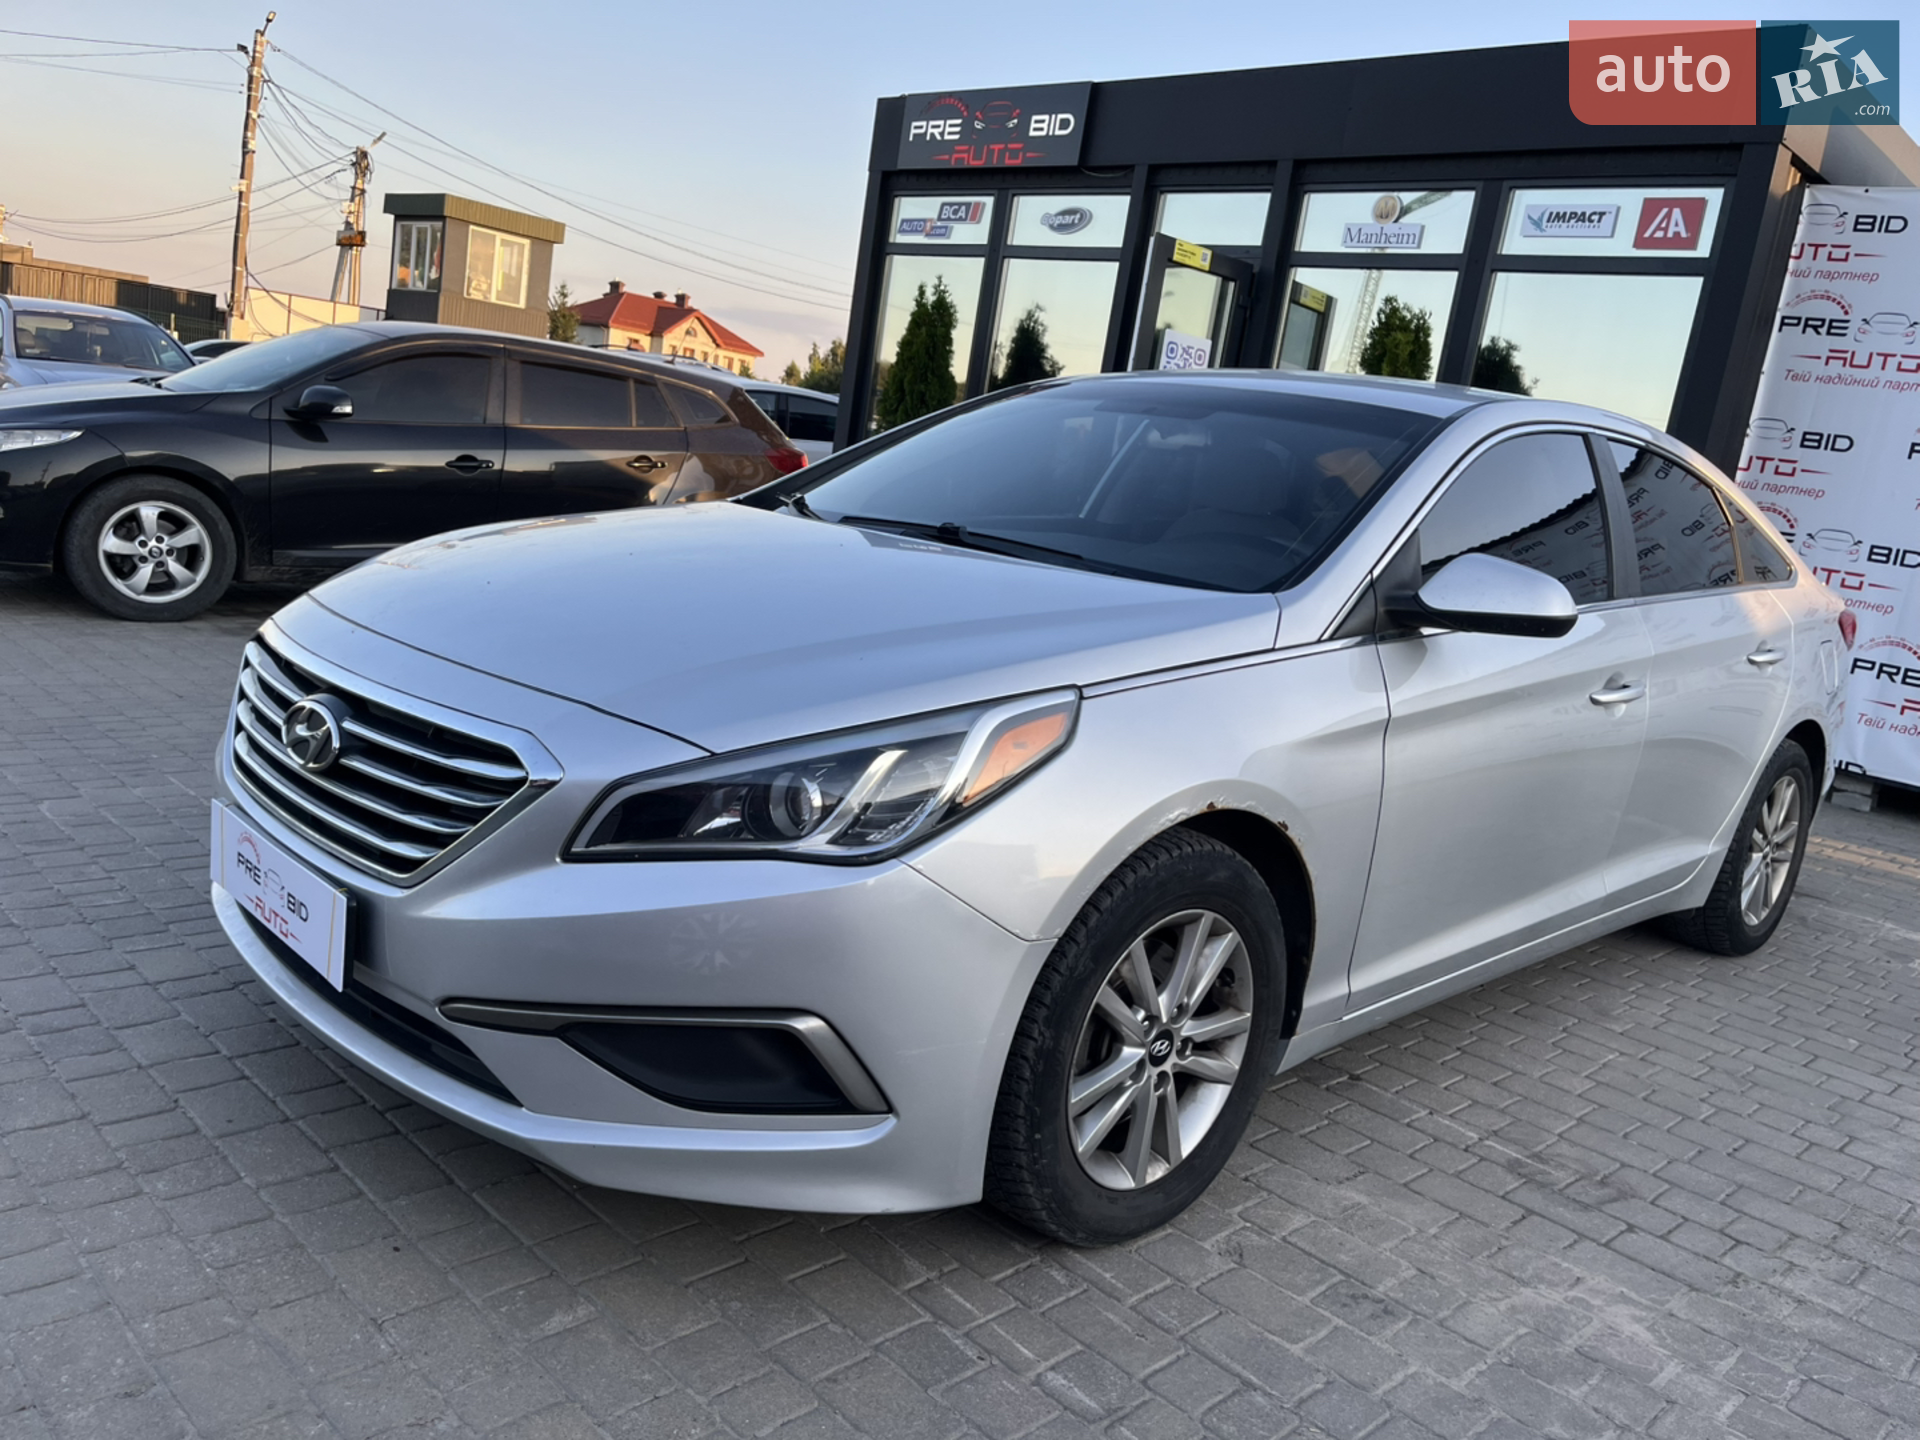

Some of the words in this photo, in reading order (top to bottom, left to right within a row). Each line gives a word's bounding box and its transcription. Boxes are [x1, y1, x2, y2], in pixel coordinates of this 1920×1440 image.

[909, 119, 963, 141] PRE
[1028, 113, 1075, 137] BID
[951, 143, 1024, 166] AUTO
[941, 204, 966, 219] BCA
[1040, 212, 1080, 227] Copart
[1546, 211, 1607, 224] IMPACT
[1852, 214, 1909, 234] BID
[1344, 227, 1417, 245] Manheim
[1789, 242, 1852, 263] UTO
[1814, 268, 1880, 284] партнер
[1778, 315, 1851, 337] PRE
[1825, 348, 1920, 373] AUTO
[1784, 368, 1812, 382] Твій
[1814, 372, 1880, 389] надійний
[1882, 378, 1920, 393] парт
[1799, 431, 1855, 453] BID
[1737, 455, 1799, 477] UTO
[1760, 481, 1826, 500] партнер
[1866, 544, 1920, 569] BID
[1850, 657, 1920, 688] PRE
[1857, 712, 1886, 729] Твій
[237, 851, 262, 886] PRE
[286, 891, 309, 922] BID
[255, 895, 289, 939] AUTO
